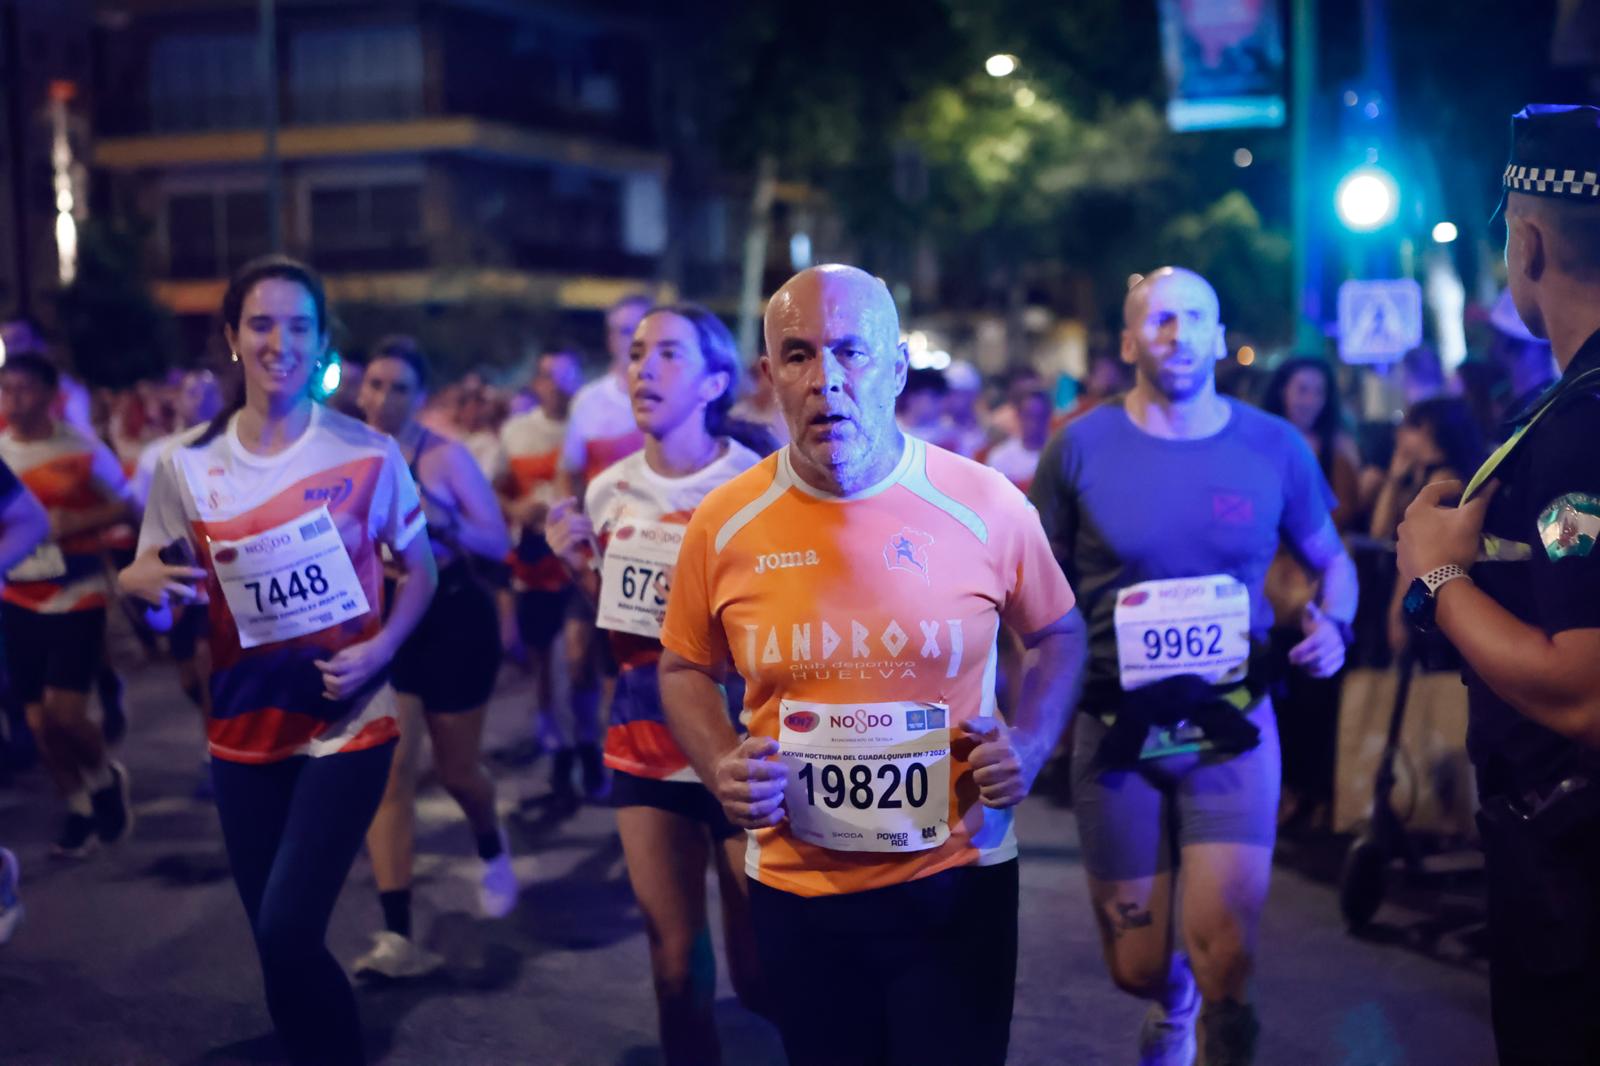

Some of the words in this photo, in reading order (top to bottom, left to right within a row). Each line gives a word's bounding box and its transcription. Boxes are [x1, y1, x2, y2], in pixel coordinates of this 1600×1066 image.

[244, 564, 329, 613] 7448
[1143, 624, 1223, 660] 9962
[790, 662, 825, 671] club
[832, 660, 916, 669] deportivo
[792, 668, 917, 680] HUELVA
[805, 752, 842, 761] NOCTURNA
[858, 752, 912, 761] GUADALQUIVIR
[929, 748, 946, 757] 2025
[798, 762, 928, 810] 19820
[876, 831, 908, 840] POWER
